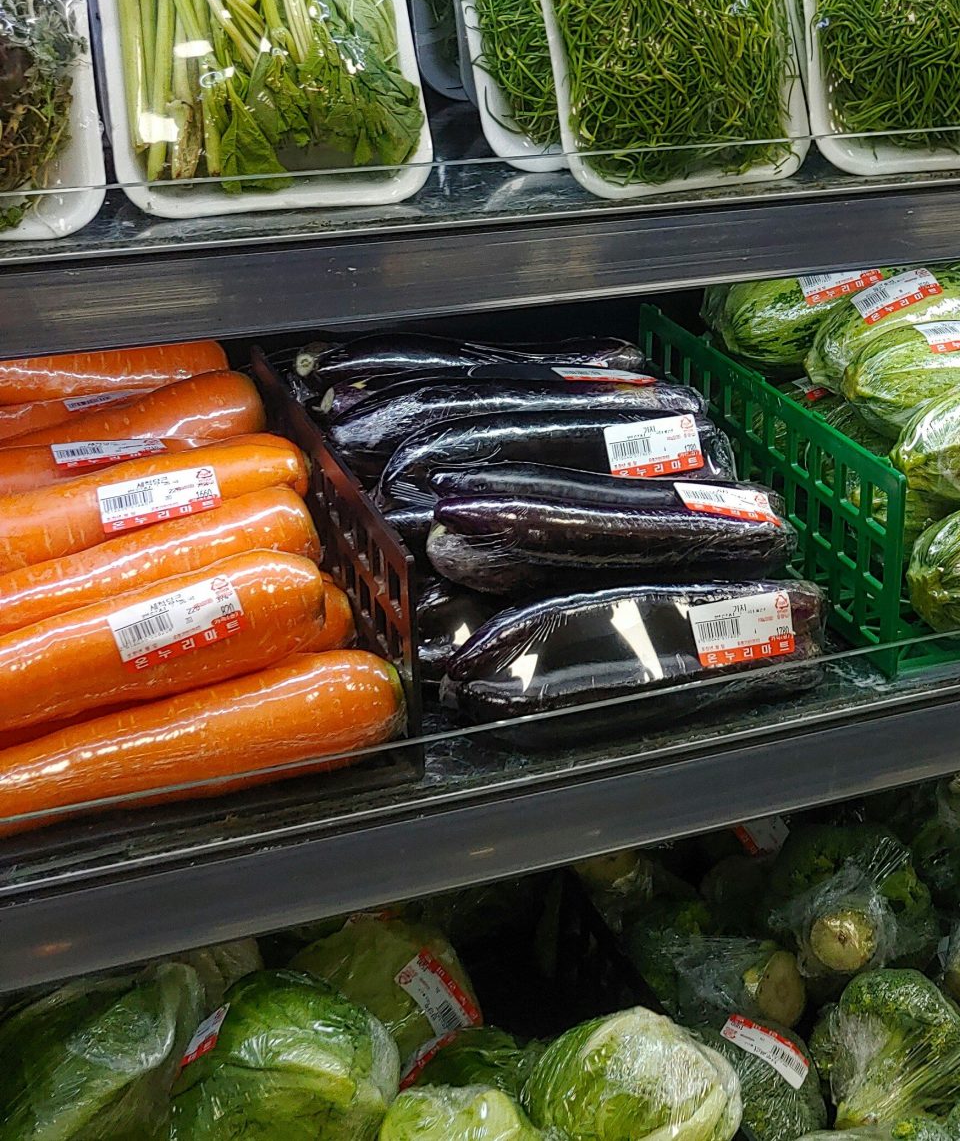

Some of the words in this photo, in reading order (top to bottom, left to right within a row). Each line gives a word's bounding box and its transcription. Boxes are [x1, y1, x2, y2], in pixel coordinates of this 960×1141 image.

[112, 500, 214, 529] 온누리마트
[134, 620, 240, 669] 온누리마트
[707, 641, 790, 663] 온누리마트
